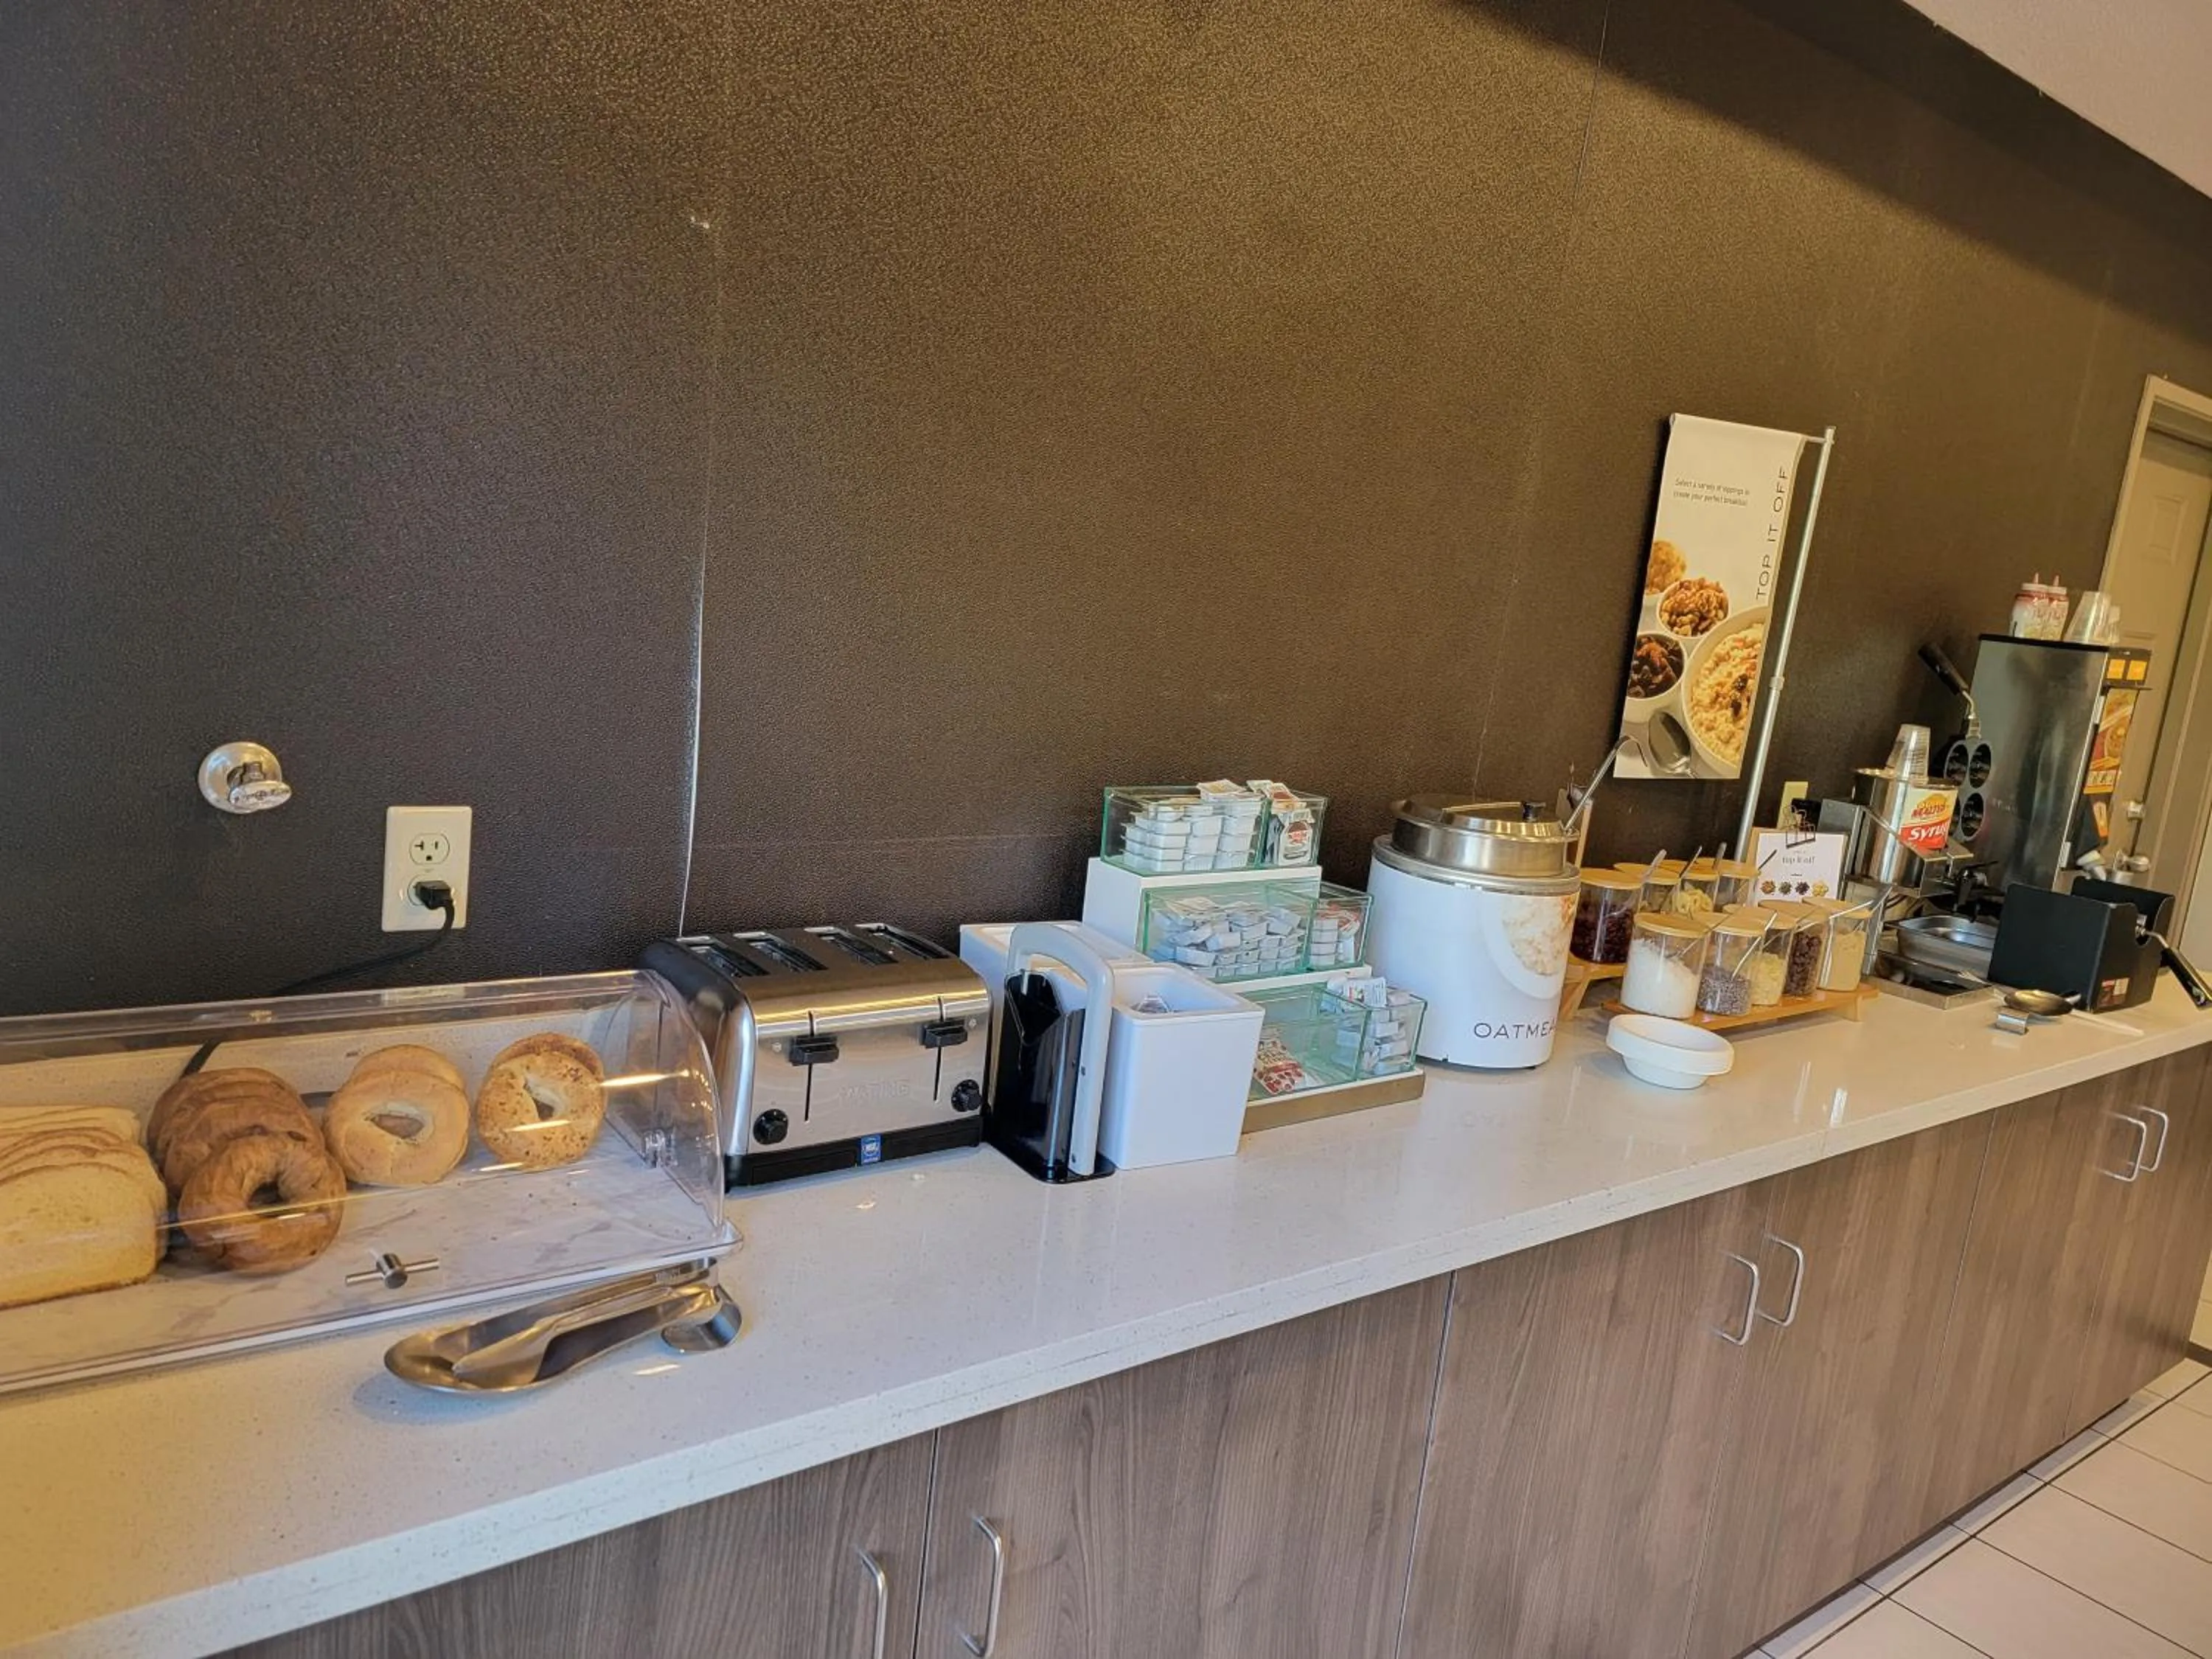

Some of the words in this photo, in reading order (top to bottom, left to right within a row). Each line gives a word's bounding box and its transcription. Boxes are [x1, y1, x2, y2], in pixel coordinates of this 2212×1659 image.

[1675, 478, 1692, 487] Select
[1691, 493, 1703, 501] your
[1703, 494, 1723, 504] perfect
[1756, 554, 1771, 599] TOP
[1767, 523, 1778, 542] IT
[1773, 466, 1788, 512] OFF
[1474, 1018, 1557, 1039] OATMEA
